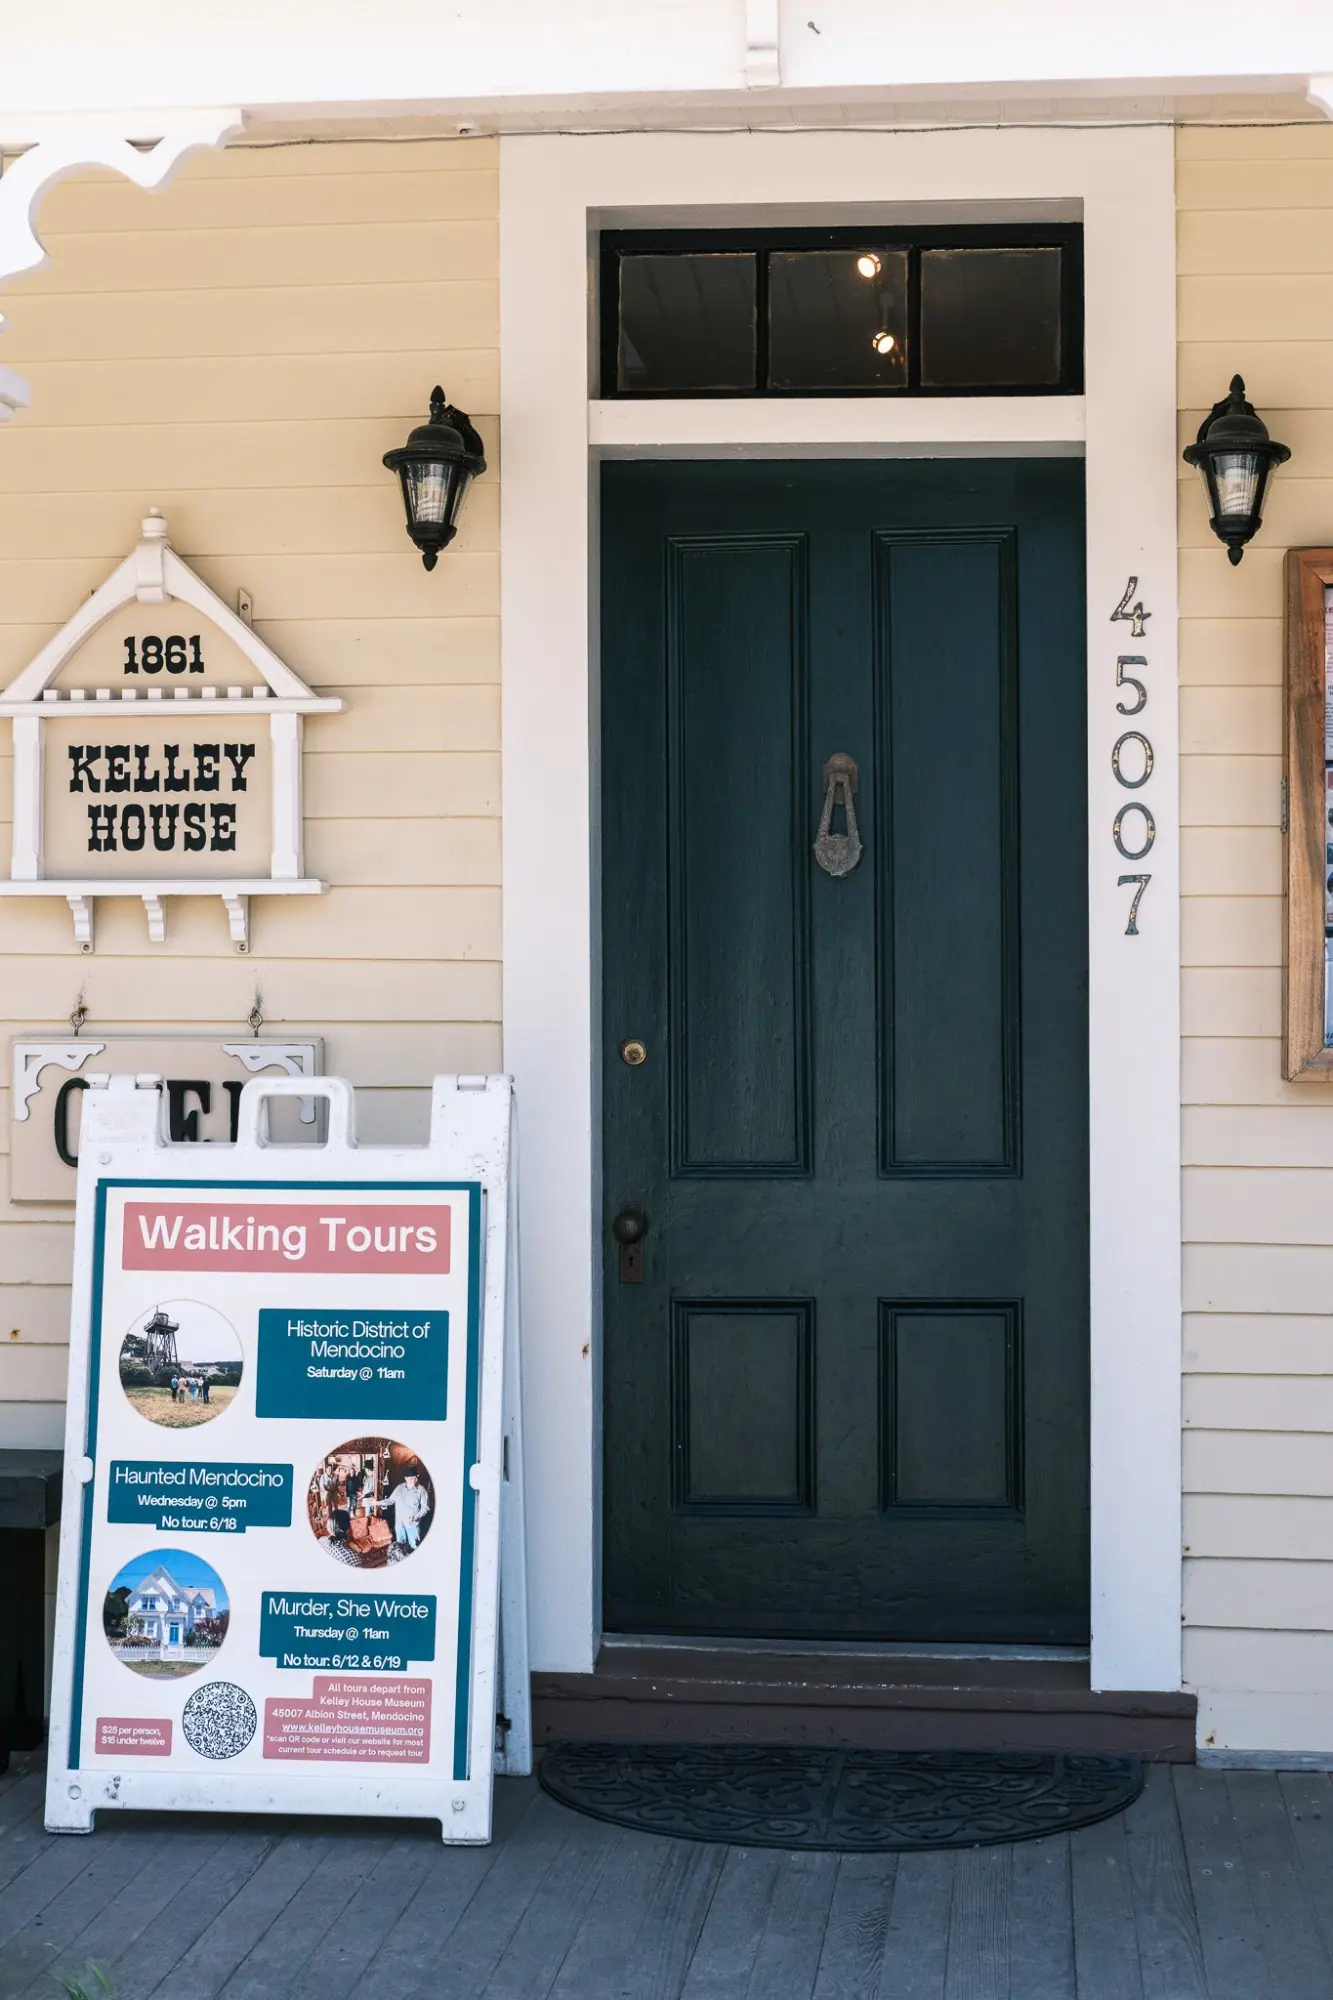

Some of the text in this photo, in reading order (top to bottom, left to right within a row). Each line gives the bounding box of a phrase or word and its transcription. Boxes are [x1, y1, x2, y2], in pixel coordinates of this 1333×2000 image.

[123, 635, 204, 674] 1861
[1110, 576, 1155, 935] 45007
[68, 743, 255, 793] KELLEY
[87, 803, 236, 852] HOUSE
[138, 1215, 437, 1260] Walking Tours
[288, 1320, 430, 1338] Historic District of
[311, 1341, 405, 1358] Mendocino
[307, 1366, 405, 1380] Saturday @ 11am
[116, 1467, 283, 1487] Haunted Mendocino
[138, 1495, 246, 1510] Wednesday @ 5pm
[162, 1516, 237, 1530] No tour: 6/18
[269, 1598, 428, 1619] Murder, She Wrote
[294, 1626, 389, 1641] Thursday @ 11am
[283, 1654, 400, 1669] No tour: 6/12 & 6/19
[328, 1684, 425, 1695] All tours depart from
[320, 1697, 425, 1707] Kelley House Museum
[272, 1709, 424, 1721] 45007 Albion Street, Mendocino
[283, 1723, 423, 1736] www.kelleyhousemuseum.org
[101, 1736, 165, 1745] $15 under twelve
[279, 1746, 305, 1754] current
[324, 1747, 357, 1755] schedule
[378, 1749, 406, 1757] request
[408, 1749, 423, 1757] tour
